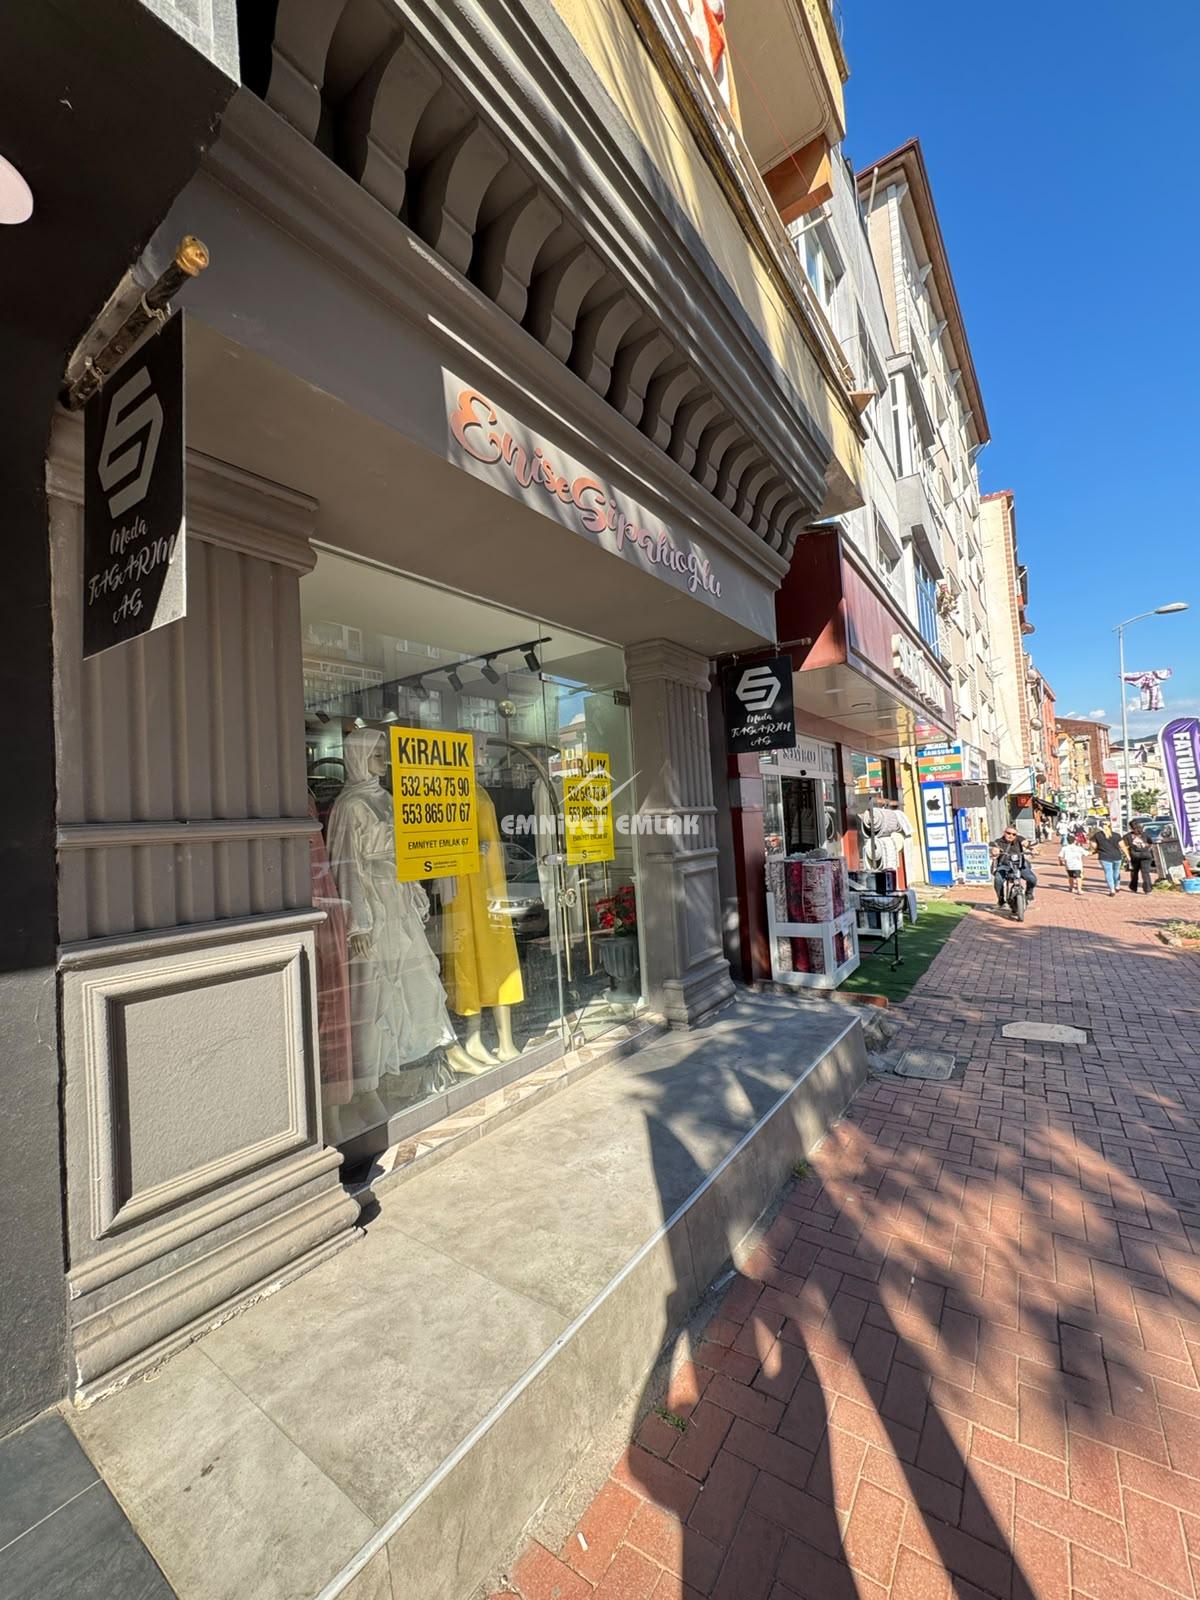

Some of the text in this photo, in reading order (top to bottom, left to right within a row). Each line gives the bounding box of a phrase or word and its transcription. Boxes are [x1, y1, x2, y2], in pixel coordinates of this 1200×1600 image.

[110, 515, 147, 555] Moda
[1173, 731, 1199, 791] FATURA
[401, 776, 470, 797] 532 543 75 90
[402, 802, 471, 825] 553 865 07 67
[439, 838, 461, 848] EMLAK
[461, 838, 469, 846] 67
[424, 861, 433, 872] S
